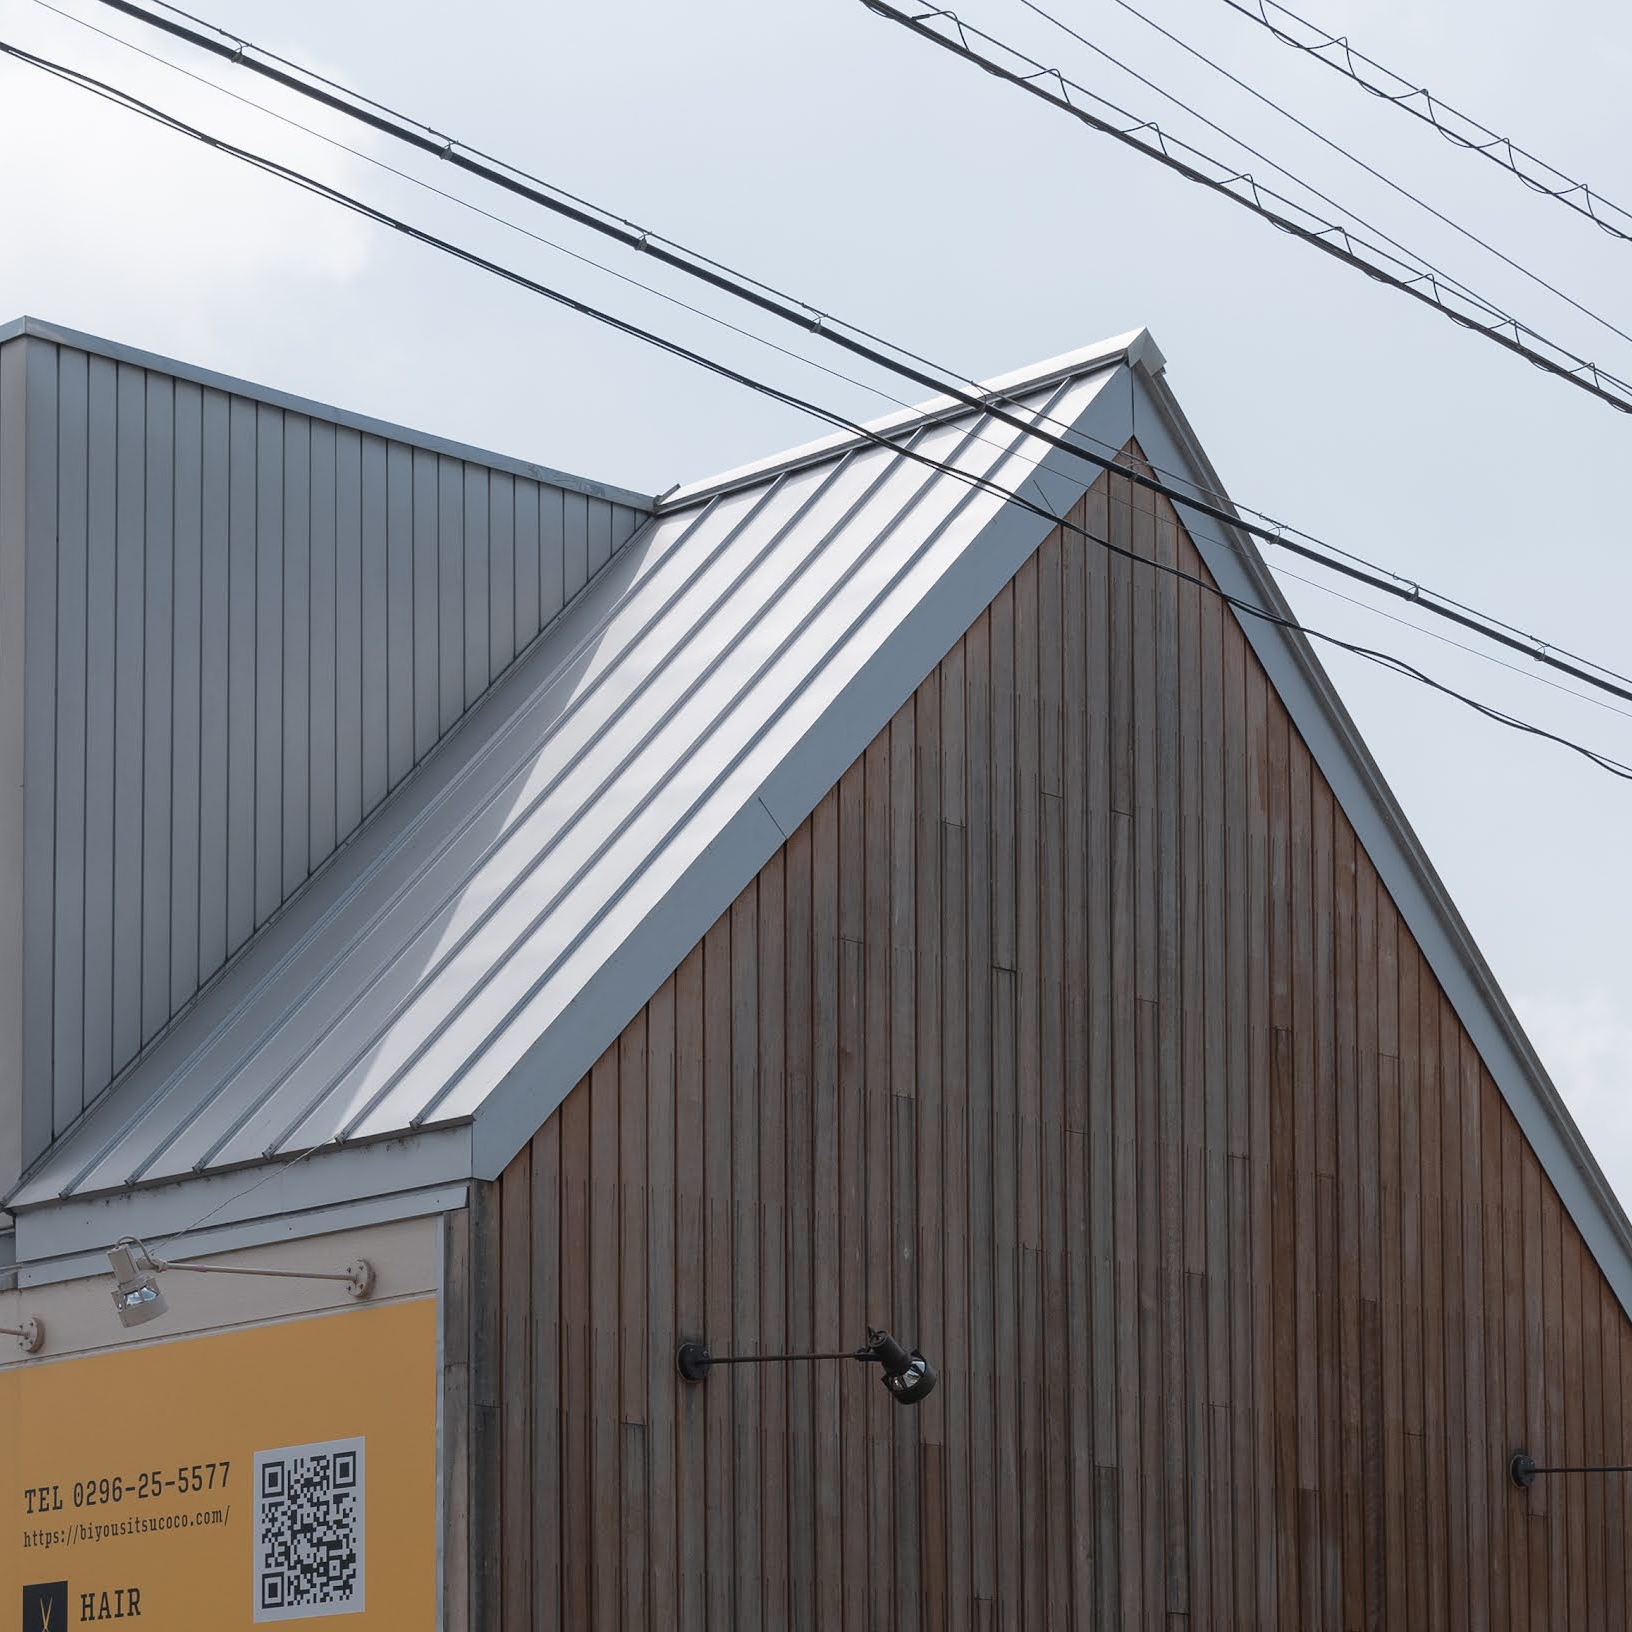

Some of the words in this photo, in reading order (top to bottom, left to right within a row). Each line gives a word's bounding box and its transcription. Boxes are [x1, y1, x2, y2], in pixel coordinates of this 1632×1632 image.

[24, 1485, 64, 1514] TEL
[73, 1461, 230, 1507] 0296-25-5577
[23, 1505, 230, 1549] https://biyousitsucoco.com/
[80, 1587, 142, 1622] HAIR
